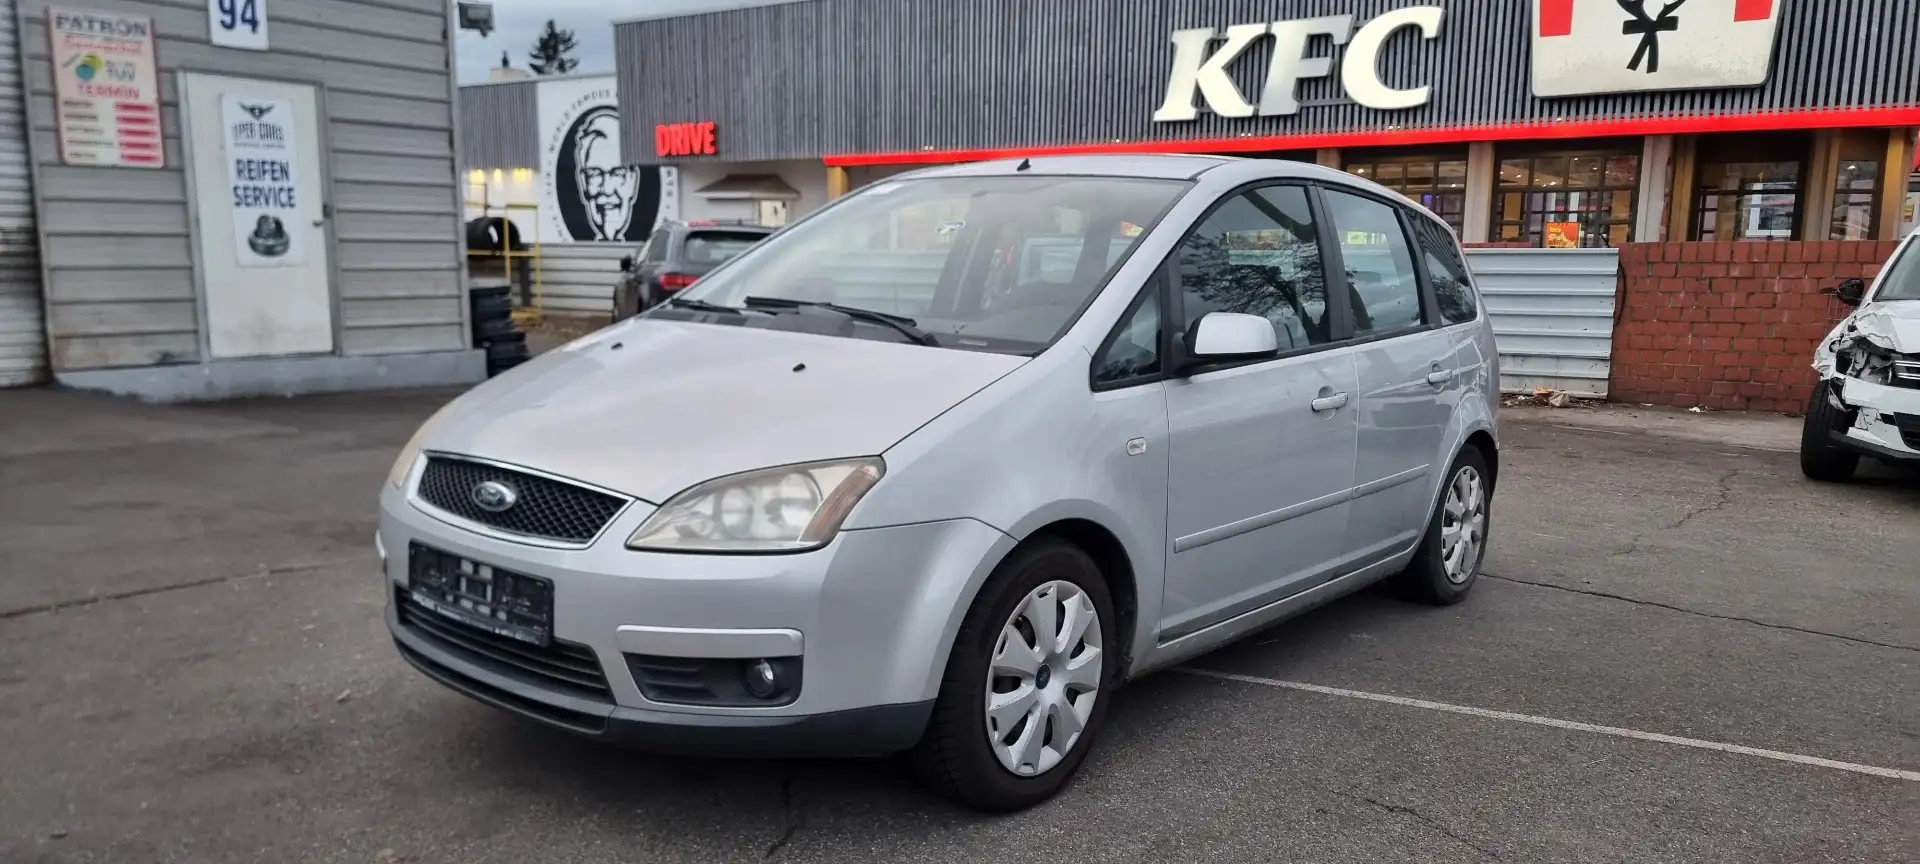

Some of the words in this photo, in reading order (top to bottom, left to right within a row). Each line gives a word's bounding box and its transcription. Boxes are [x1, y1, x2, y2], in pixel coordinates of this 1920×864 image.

[219, 0, 259, 34] 94
[1153, 5, 1444, 122] KFC
[656, 121, 717, 156] DRIVE
[236, 159, 290, 182] REIFEN
[233, 185, 297, 209] SERVICE
